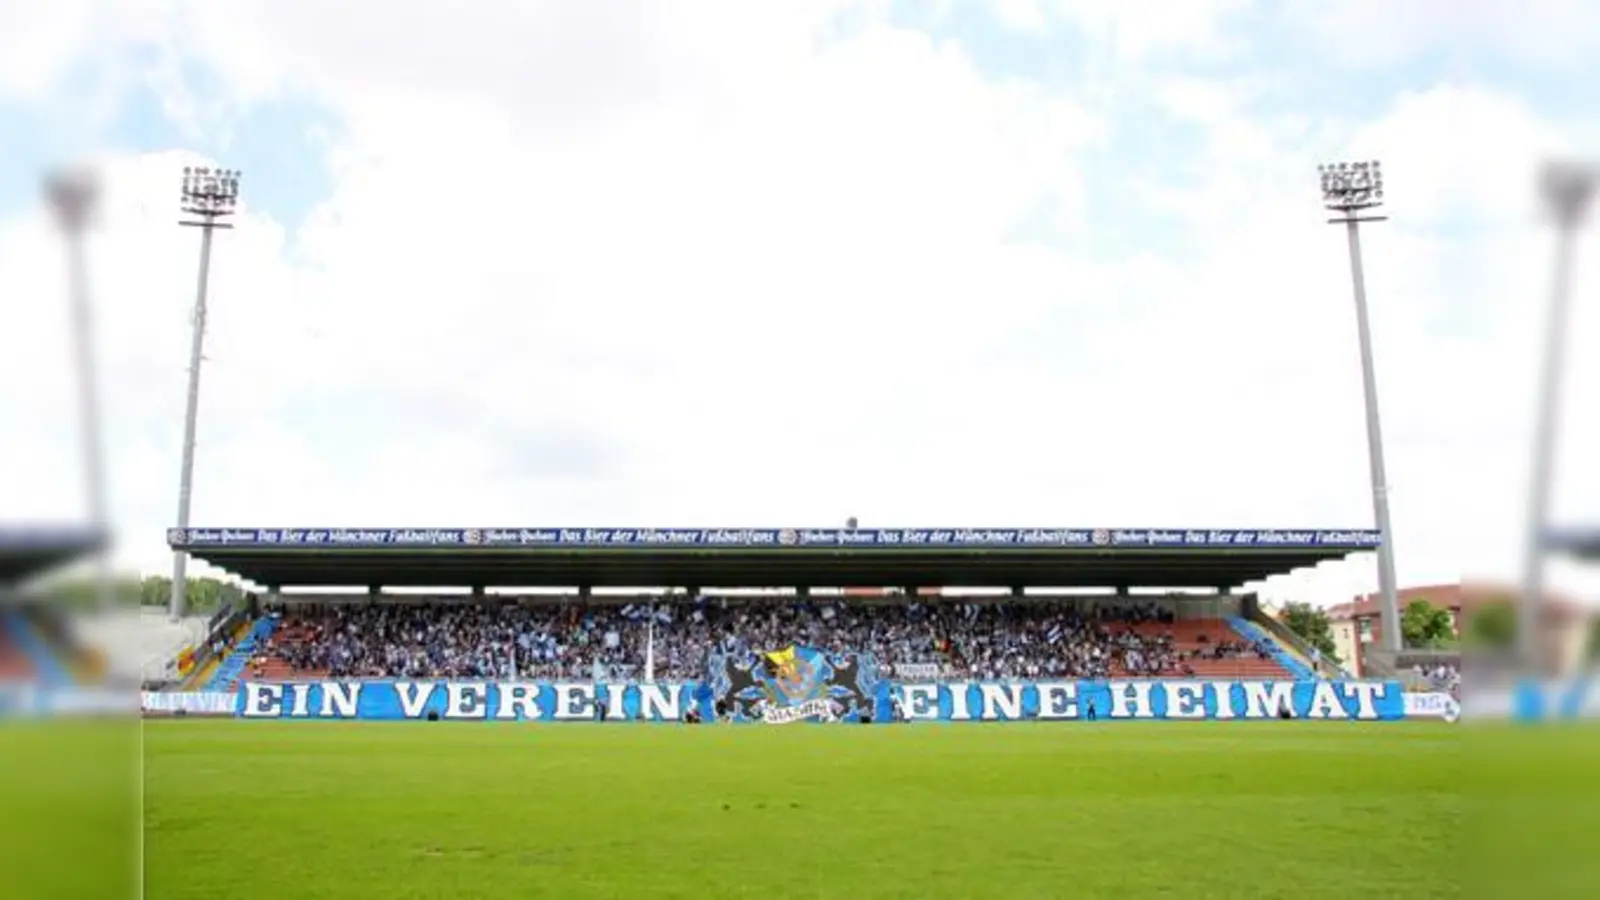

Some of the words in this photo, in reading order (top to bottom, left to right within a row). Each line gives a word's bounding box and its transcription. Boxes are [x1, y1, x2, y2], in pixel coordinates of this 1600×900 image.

[259, 529, 278, 541] Das
[282, 529, 303, 541] Bier
[306, 529, 328, 541] der
[560, 530, 581, 542] Das
[585, 530, 607, 542] Bier
[611, 530, 635, 542] der
[878, 530, 900, 542] Das
[903, 530, 926, 542] Bier
[929, 530, 952, 542] der
[1185, 530, 1206, 542] Das
[1209, 530, 1233, 542] Bier
[1235, 530, 1256, 542] der
[243, 682, 361, 718] EIN
[395, 682, 682, 719] VEREIN
[901, 683, 1078, 719] EINE
[1110, 682, 1384, 719] HEIMAT
